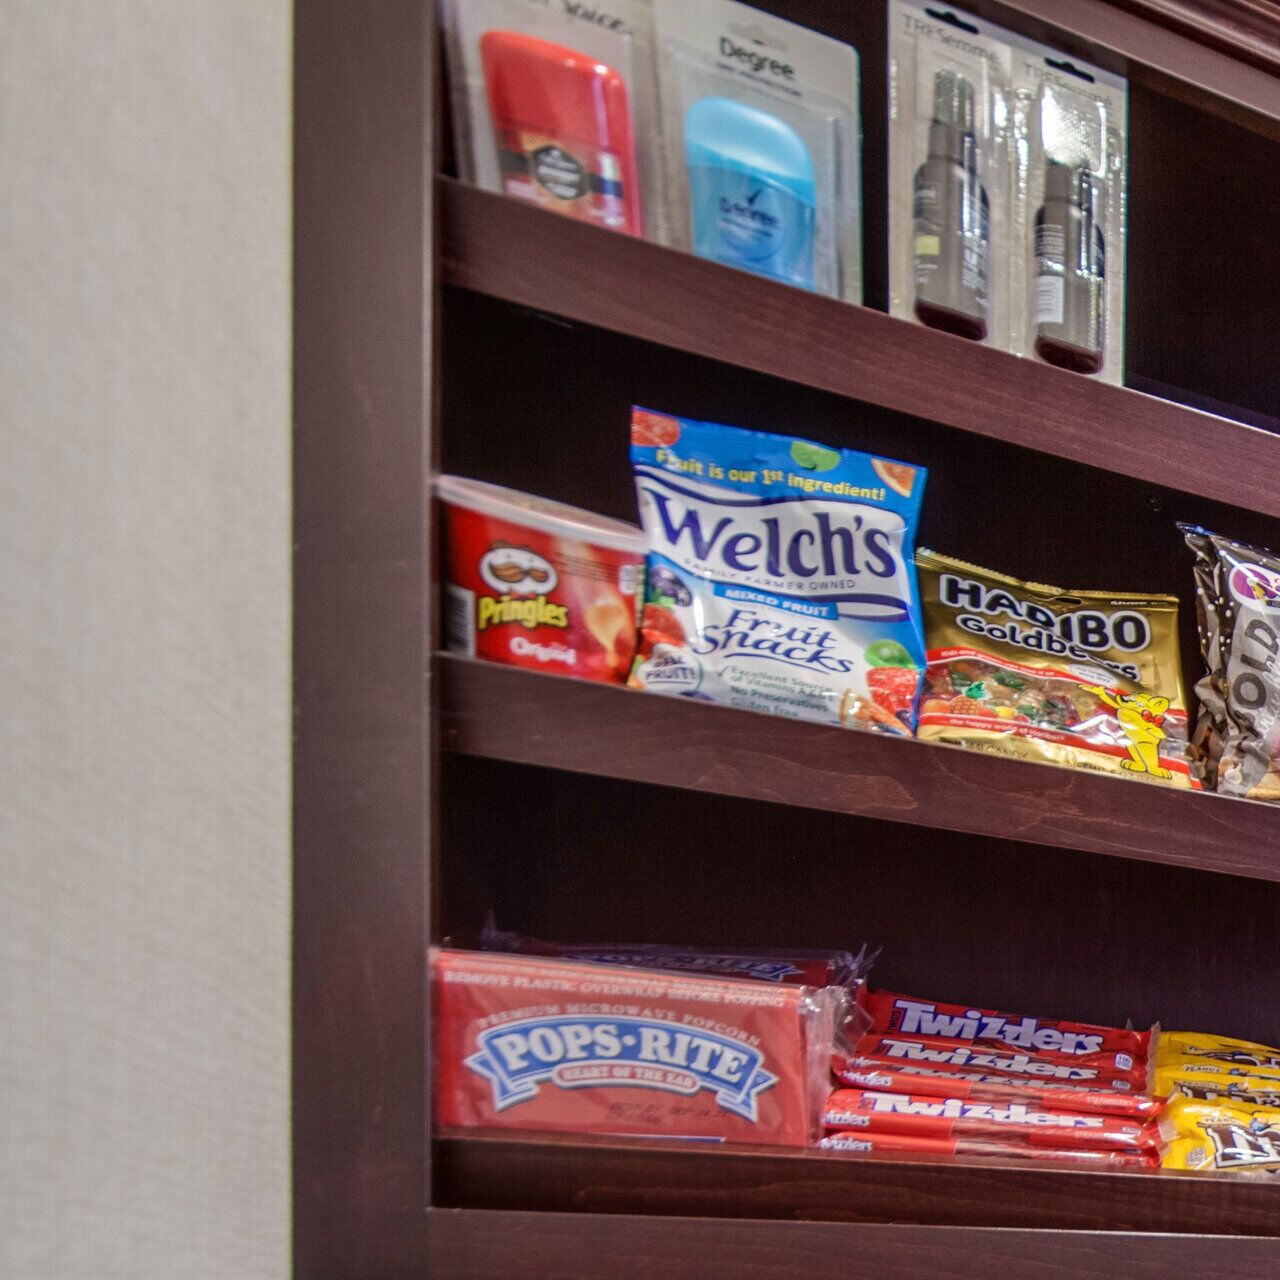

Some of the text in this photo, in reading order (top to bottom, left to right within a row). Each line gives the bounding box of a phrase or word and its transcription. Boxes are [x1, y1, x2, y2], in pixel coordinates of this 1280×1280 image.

[718, 35, 796, 80] Degree
[656, 449, 704, 475] Fruit
[708, 463, 725, 478] is
[727, 467, 757, 482] our
[762, 469, 784, 485] 1st
[642, 486, 897, 579] Welch's
[724, 588, 830, 617] MIXED FRUIT
[745, 574, 807, 592] FARMER
[808, 579, 857, 592] OWNED
[477, 595, 569, 630] Pringles
[726, 608, 838, 649] Fruit
[939, 574, 1150, 652] HARIBO
[692, 625, 855, 673] Snacks
[956, 614, 1142, 682] Goldbes
[512, 976, 577, 991] PLASTIC
[565, 1003, 677, 1021] MICROWAVE
[682, 1013, 763, 1047] POPCORN
[894, 999, 1104, 1055] Twizzlers
[633, 1065, 663, 1080] THE
[880, 1038, 1099, 1081] Twizzlers
[861, 1092, 1104, 1128] Twizzlers
